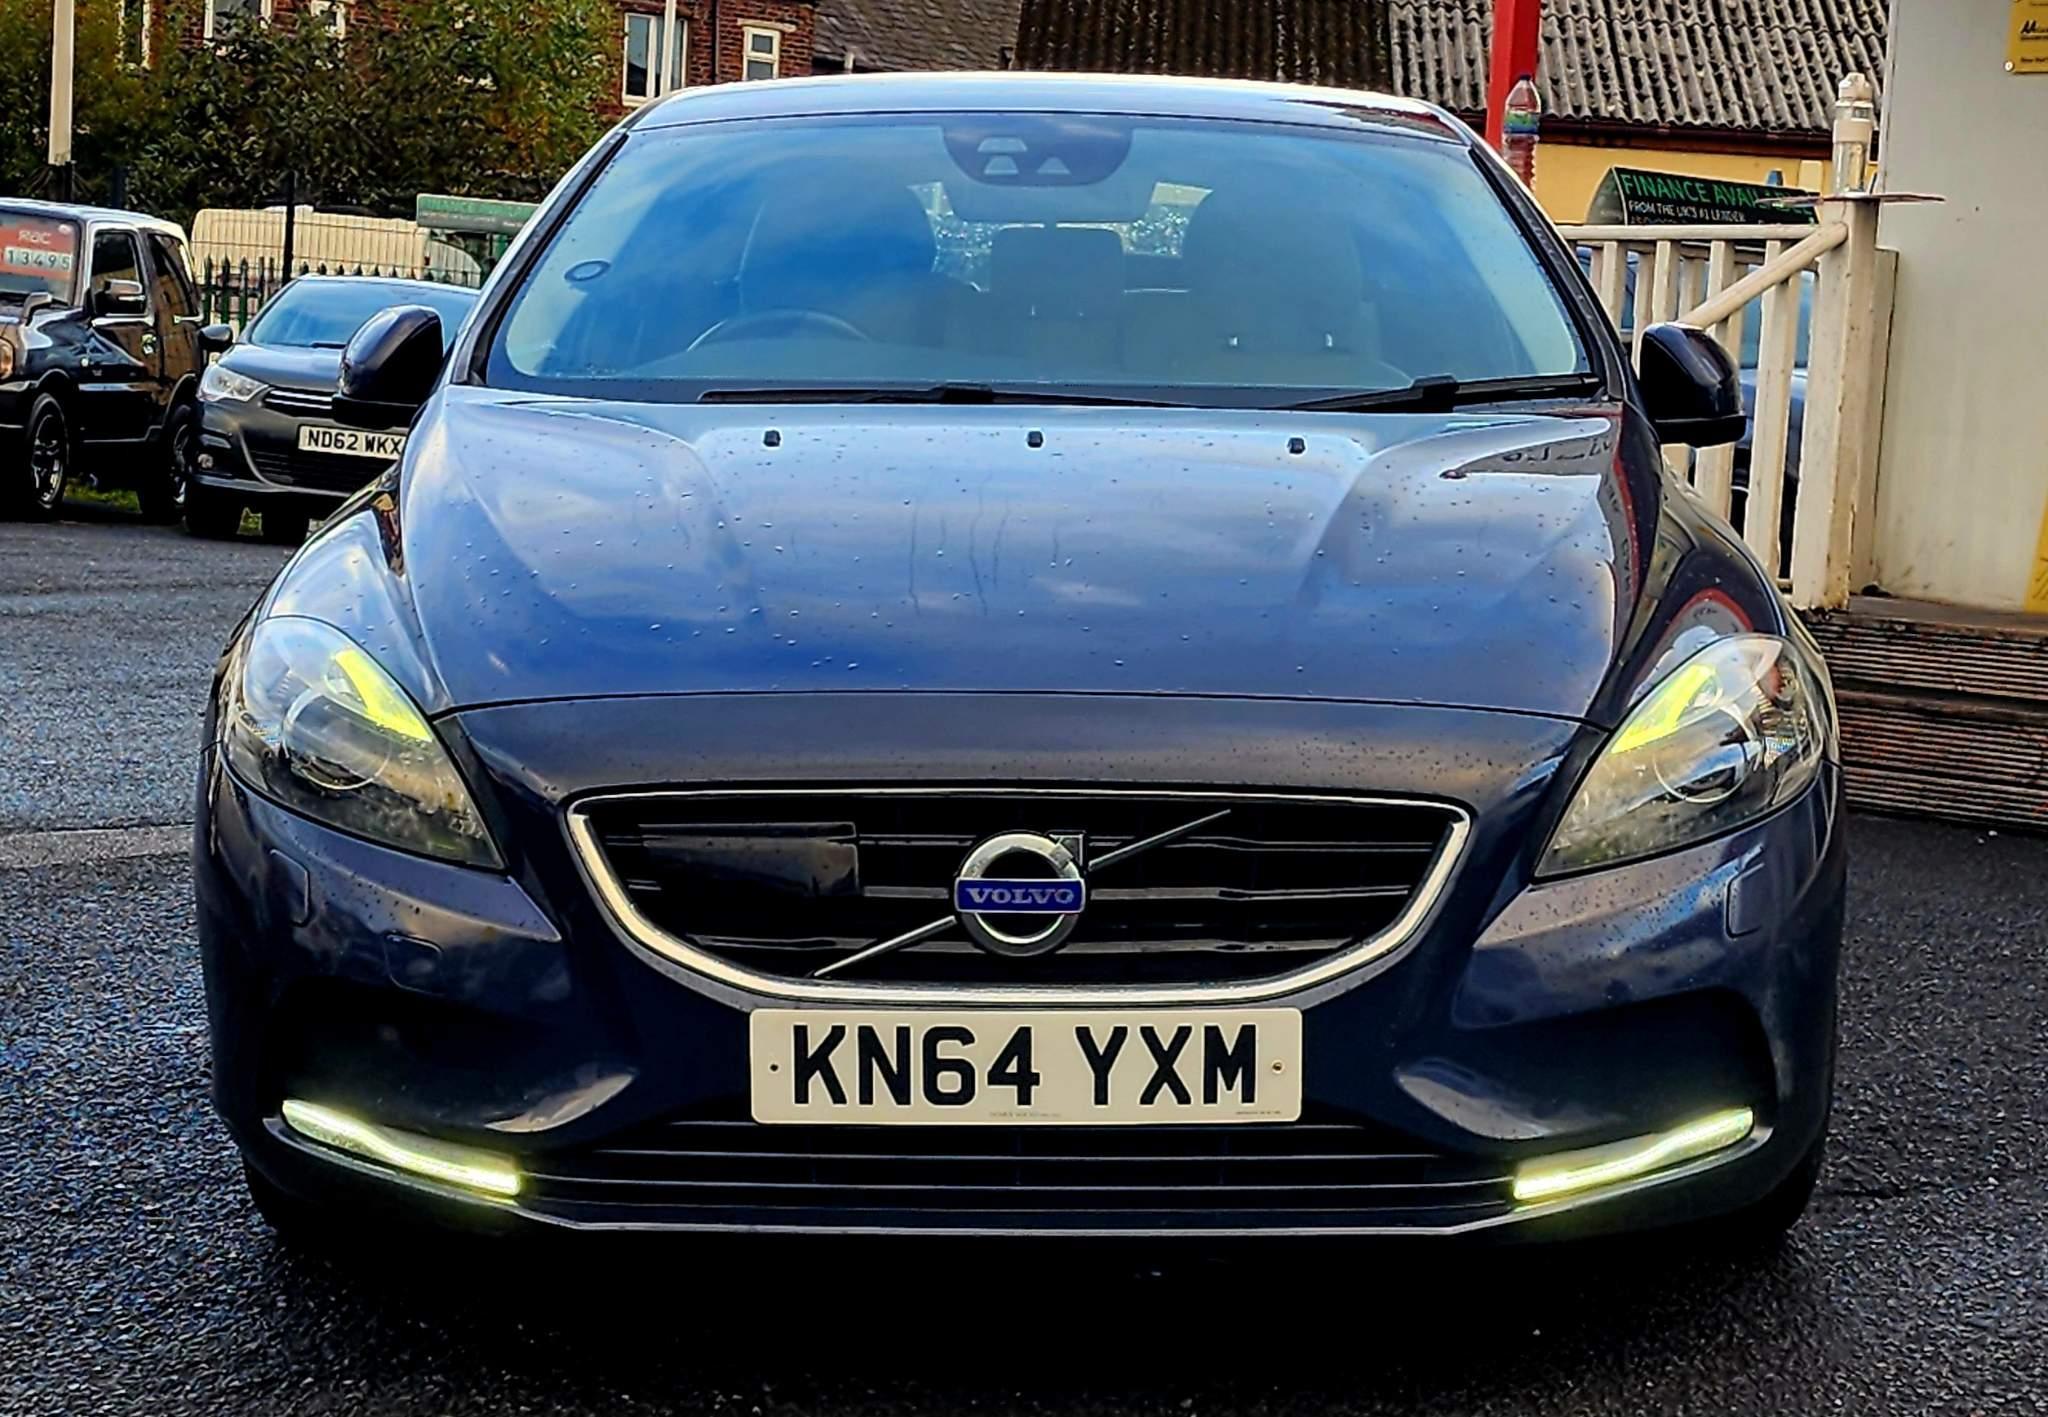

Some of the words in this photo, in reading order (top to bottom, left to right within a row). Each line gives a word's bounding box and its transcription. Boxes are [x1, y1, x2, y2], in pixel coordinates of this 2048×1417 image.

[1620, 174, 1711, 203] FINANCE
[307, 429, 359, 451] ND62
[364, 435, 403, 455] WKX
[965, 888, 1075, 905] VOLVO
[792, 1024, 1041, 1106] KN64
[1075, 1024, 1257, 1106] YXM
